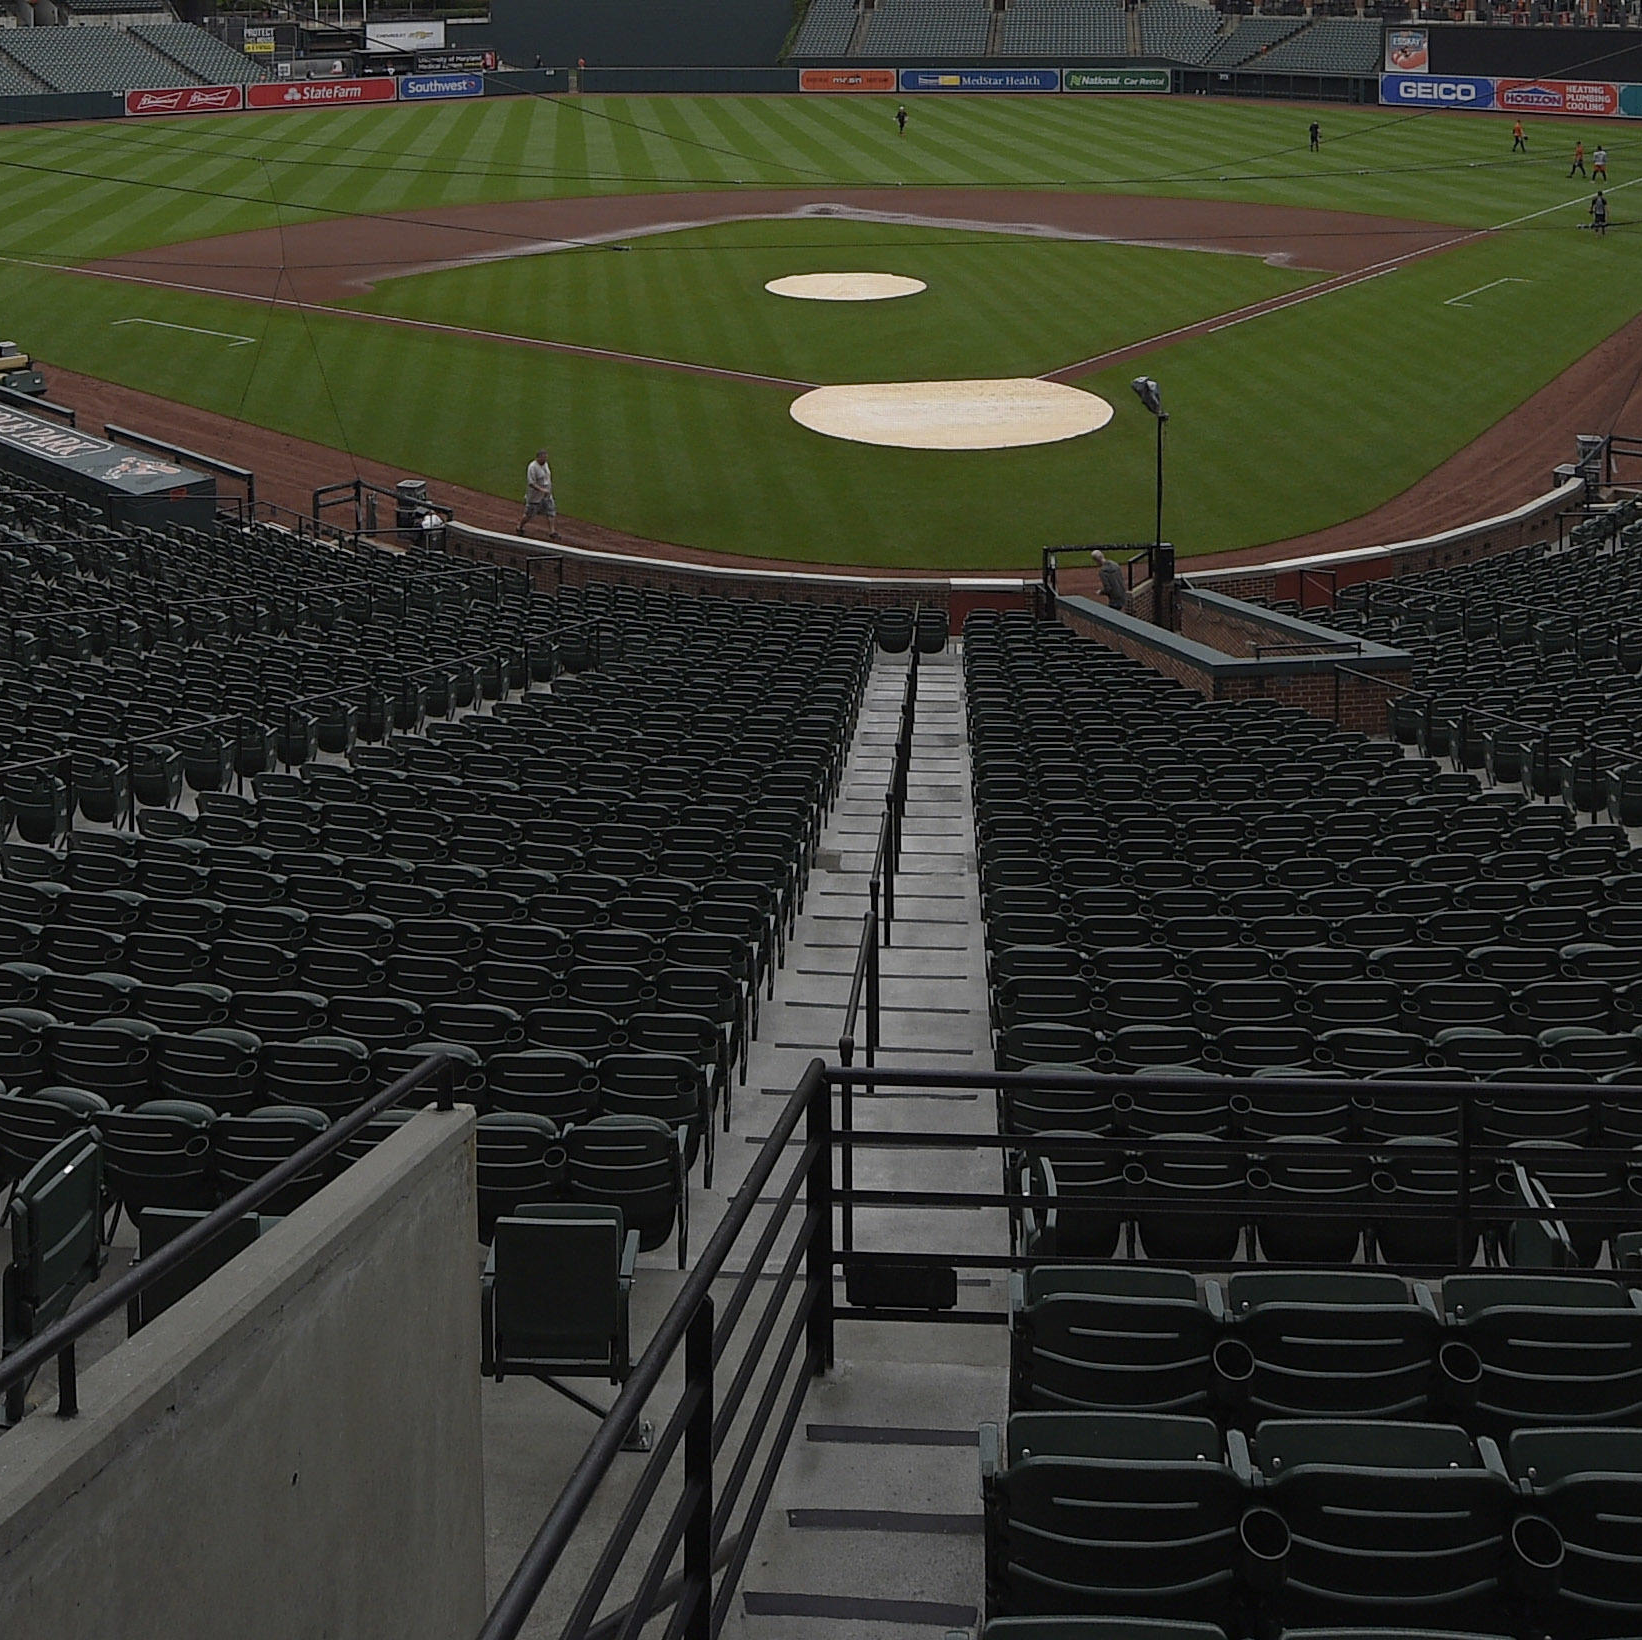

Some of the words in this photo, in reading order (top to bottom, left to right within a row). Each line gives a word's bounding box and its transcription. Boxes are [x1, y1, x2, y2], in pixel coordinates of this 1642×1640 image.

[244, 28, 275, 38] PROTECT
[1392, 36, 1422, 48] ESSKAY
[962, 75, 1003, 86] MedStar
[1005, 75, 1041, 86] Health
[1081, 76, 1120, 86] National
[1123, 77, 1139, 86] Car
[1139, 77, 1165, 86] Rental
[407, 79, 468, 94] Southwest
[1399, 80, 1477, 102] GEICO
[1565, 85, 1605, 95] HEATING
[1504, 92, 1562, 106] HORIZON
[1565, 93, 1612, 104] PLUMBING
[1565, 102, 1606, 112] COOLING
[11, 427, 101, 456] PARK
